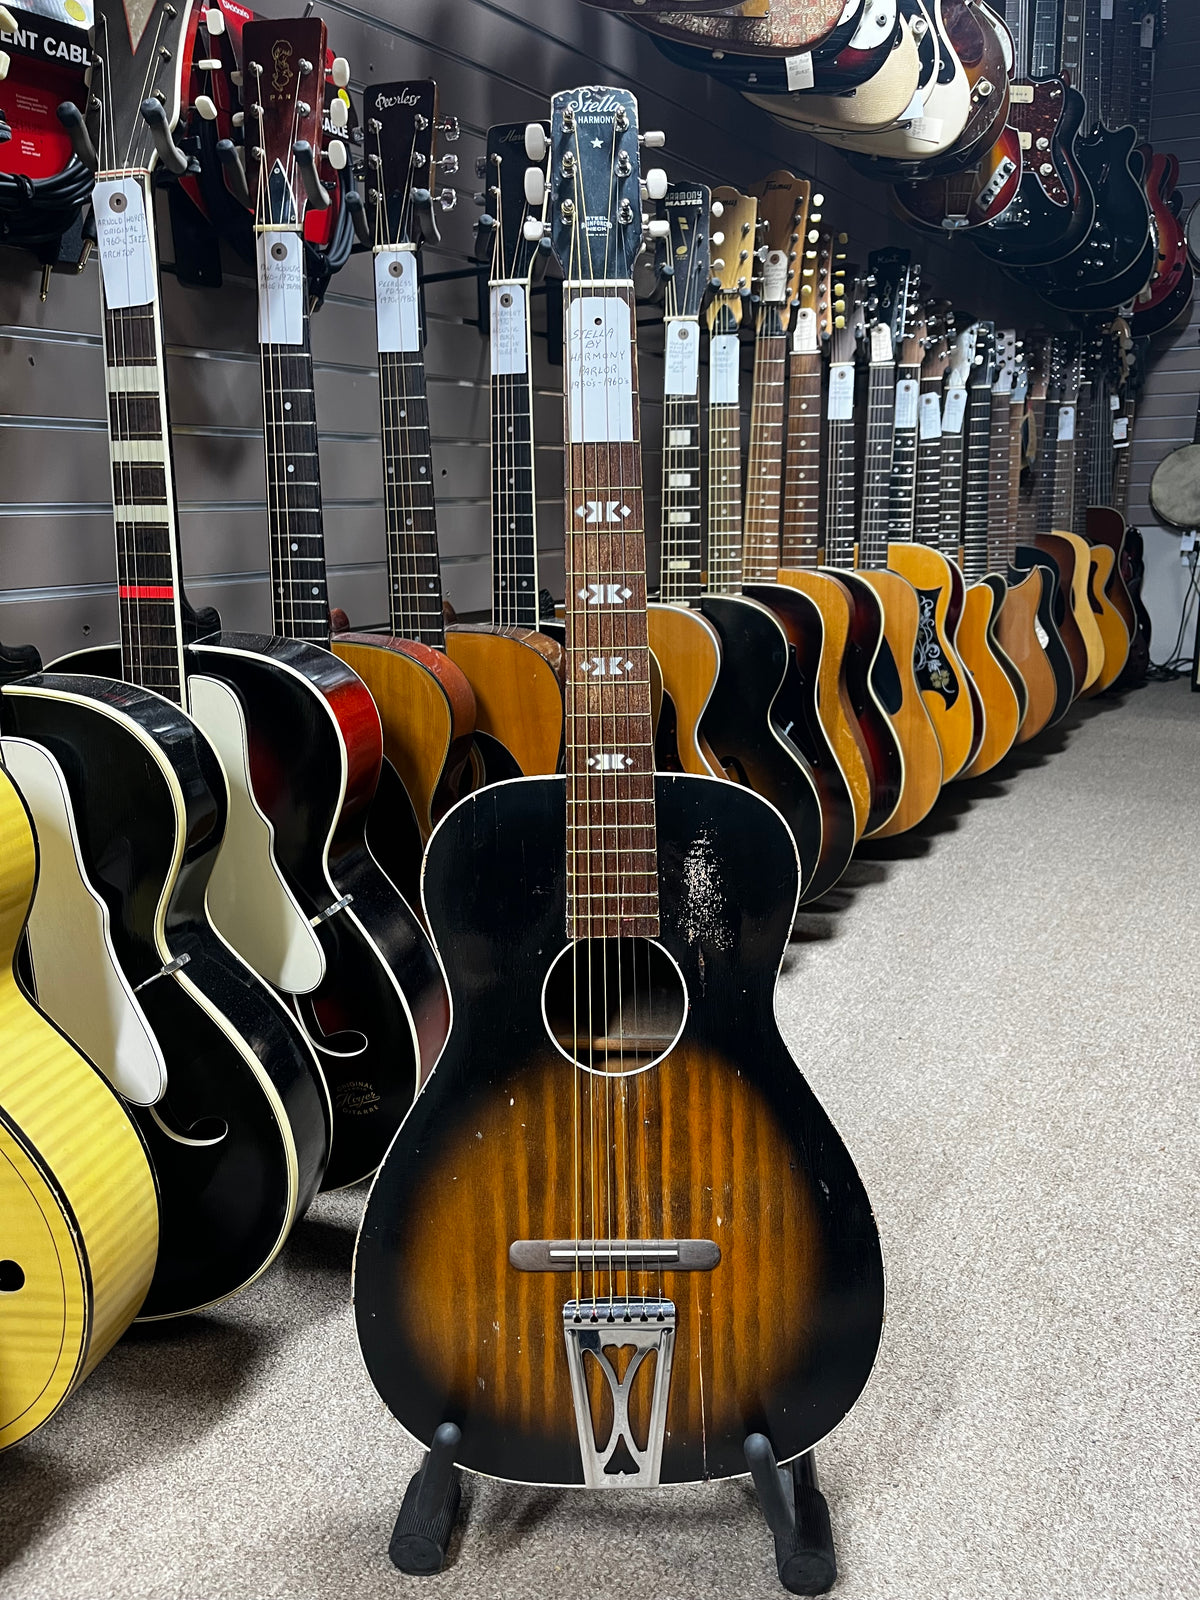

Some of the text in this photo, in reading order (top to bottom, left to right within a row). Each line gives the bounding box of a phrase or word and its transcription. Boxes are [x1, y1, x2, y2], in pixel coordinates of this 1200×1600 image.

[269, 93, 291, 101] PAN
[375, 87, 421, 111] Peerless
[568, 89, 619, 113] Stella
[578, 115, 615, 125] HARMONY
[321, 117, 350, 139] ABLE
[665, 190, 703, 200] HARMONY
[665, 199, 703, 207] MASTER
[98, 217, 123, 226] ARNOLD
[571, 327, 614, 340] STELLA
[585, 340, 602, 348] BY
[570, 350, 626, 362] HARMONY
[579, 363, 617, 377] PARLOR
